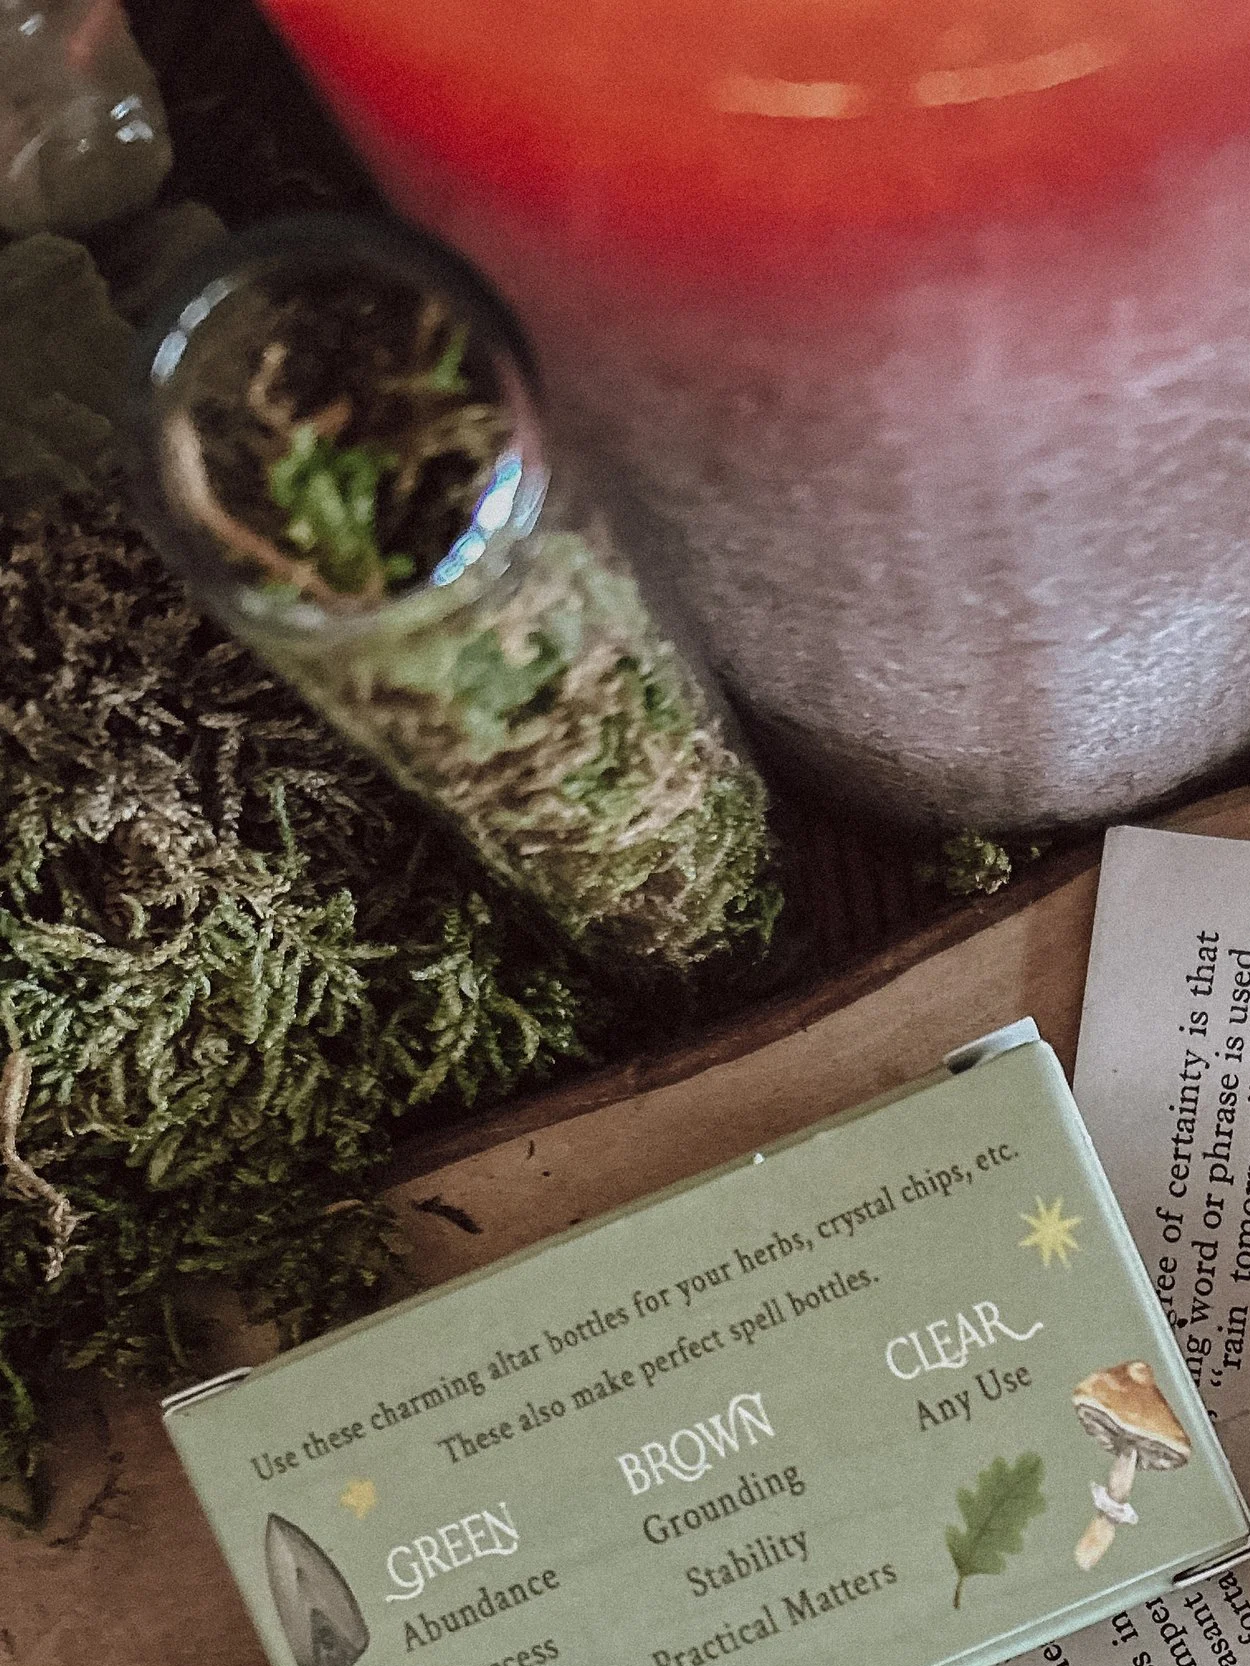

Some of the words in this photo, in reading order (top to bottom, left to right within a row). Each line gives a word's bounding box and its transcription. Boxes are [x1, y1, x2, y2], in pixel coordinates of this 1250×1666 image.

[1184, 928, 1220, 997] that
[1177, 1009, 1209, 1038] is
[1213, 1034, 1245, 1064] is
[1167, 1047, 1211, 1199] certainty
[1200, 1072, 1240, 1187] phrase
[1154, 1204, 1184, 1244] of
[1201, 1191, 1225, 1230] or
[248, 1450, 300, 1481] Use
[300, 1420, 367, 1461] these
[369, 1369, 486, 1431] charming
[486, 1342, 542, 1381] altar
[540, 1306, 630, 1356] bottles
[631, 1287, 672, 1319] for
[673, 1261, 734, 1308] your
[731, 1230, 814, 1275] herbs,
[814, 1184, 897, 1239] crystal
[899, 1163, 973, 1204] chips,
[974, 1142, 1020, 1172] etc.
[1176, 1239, 1219, 1324] word
[432, 1420, 515, 1464] These
[517, 1398, 567, 1433] also
[569, 1367, 636, 1411] make
[637, 1328, 726, 1389] perfect
[727, 1296, 788, 1346] spell
[783, 1268, 881, 1317] bottles.
[884, 1300, 1045, 1380] CLEAR
[915, 1388, 972, 1433] Any
[972, 1365, 1033, 1402] Use
[616, 1391, 775, 1496] BROWN
[641, 1464, 806, 1545] Grounding
[383, 1500, 520, 1603] GREEN
[684, 1529, 809, 1598] Stability
[402, 1568, 561, 1654] Abundance
[779, 1562, 898, 1627] Matters
